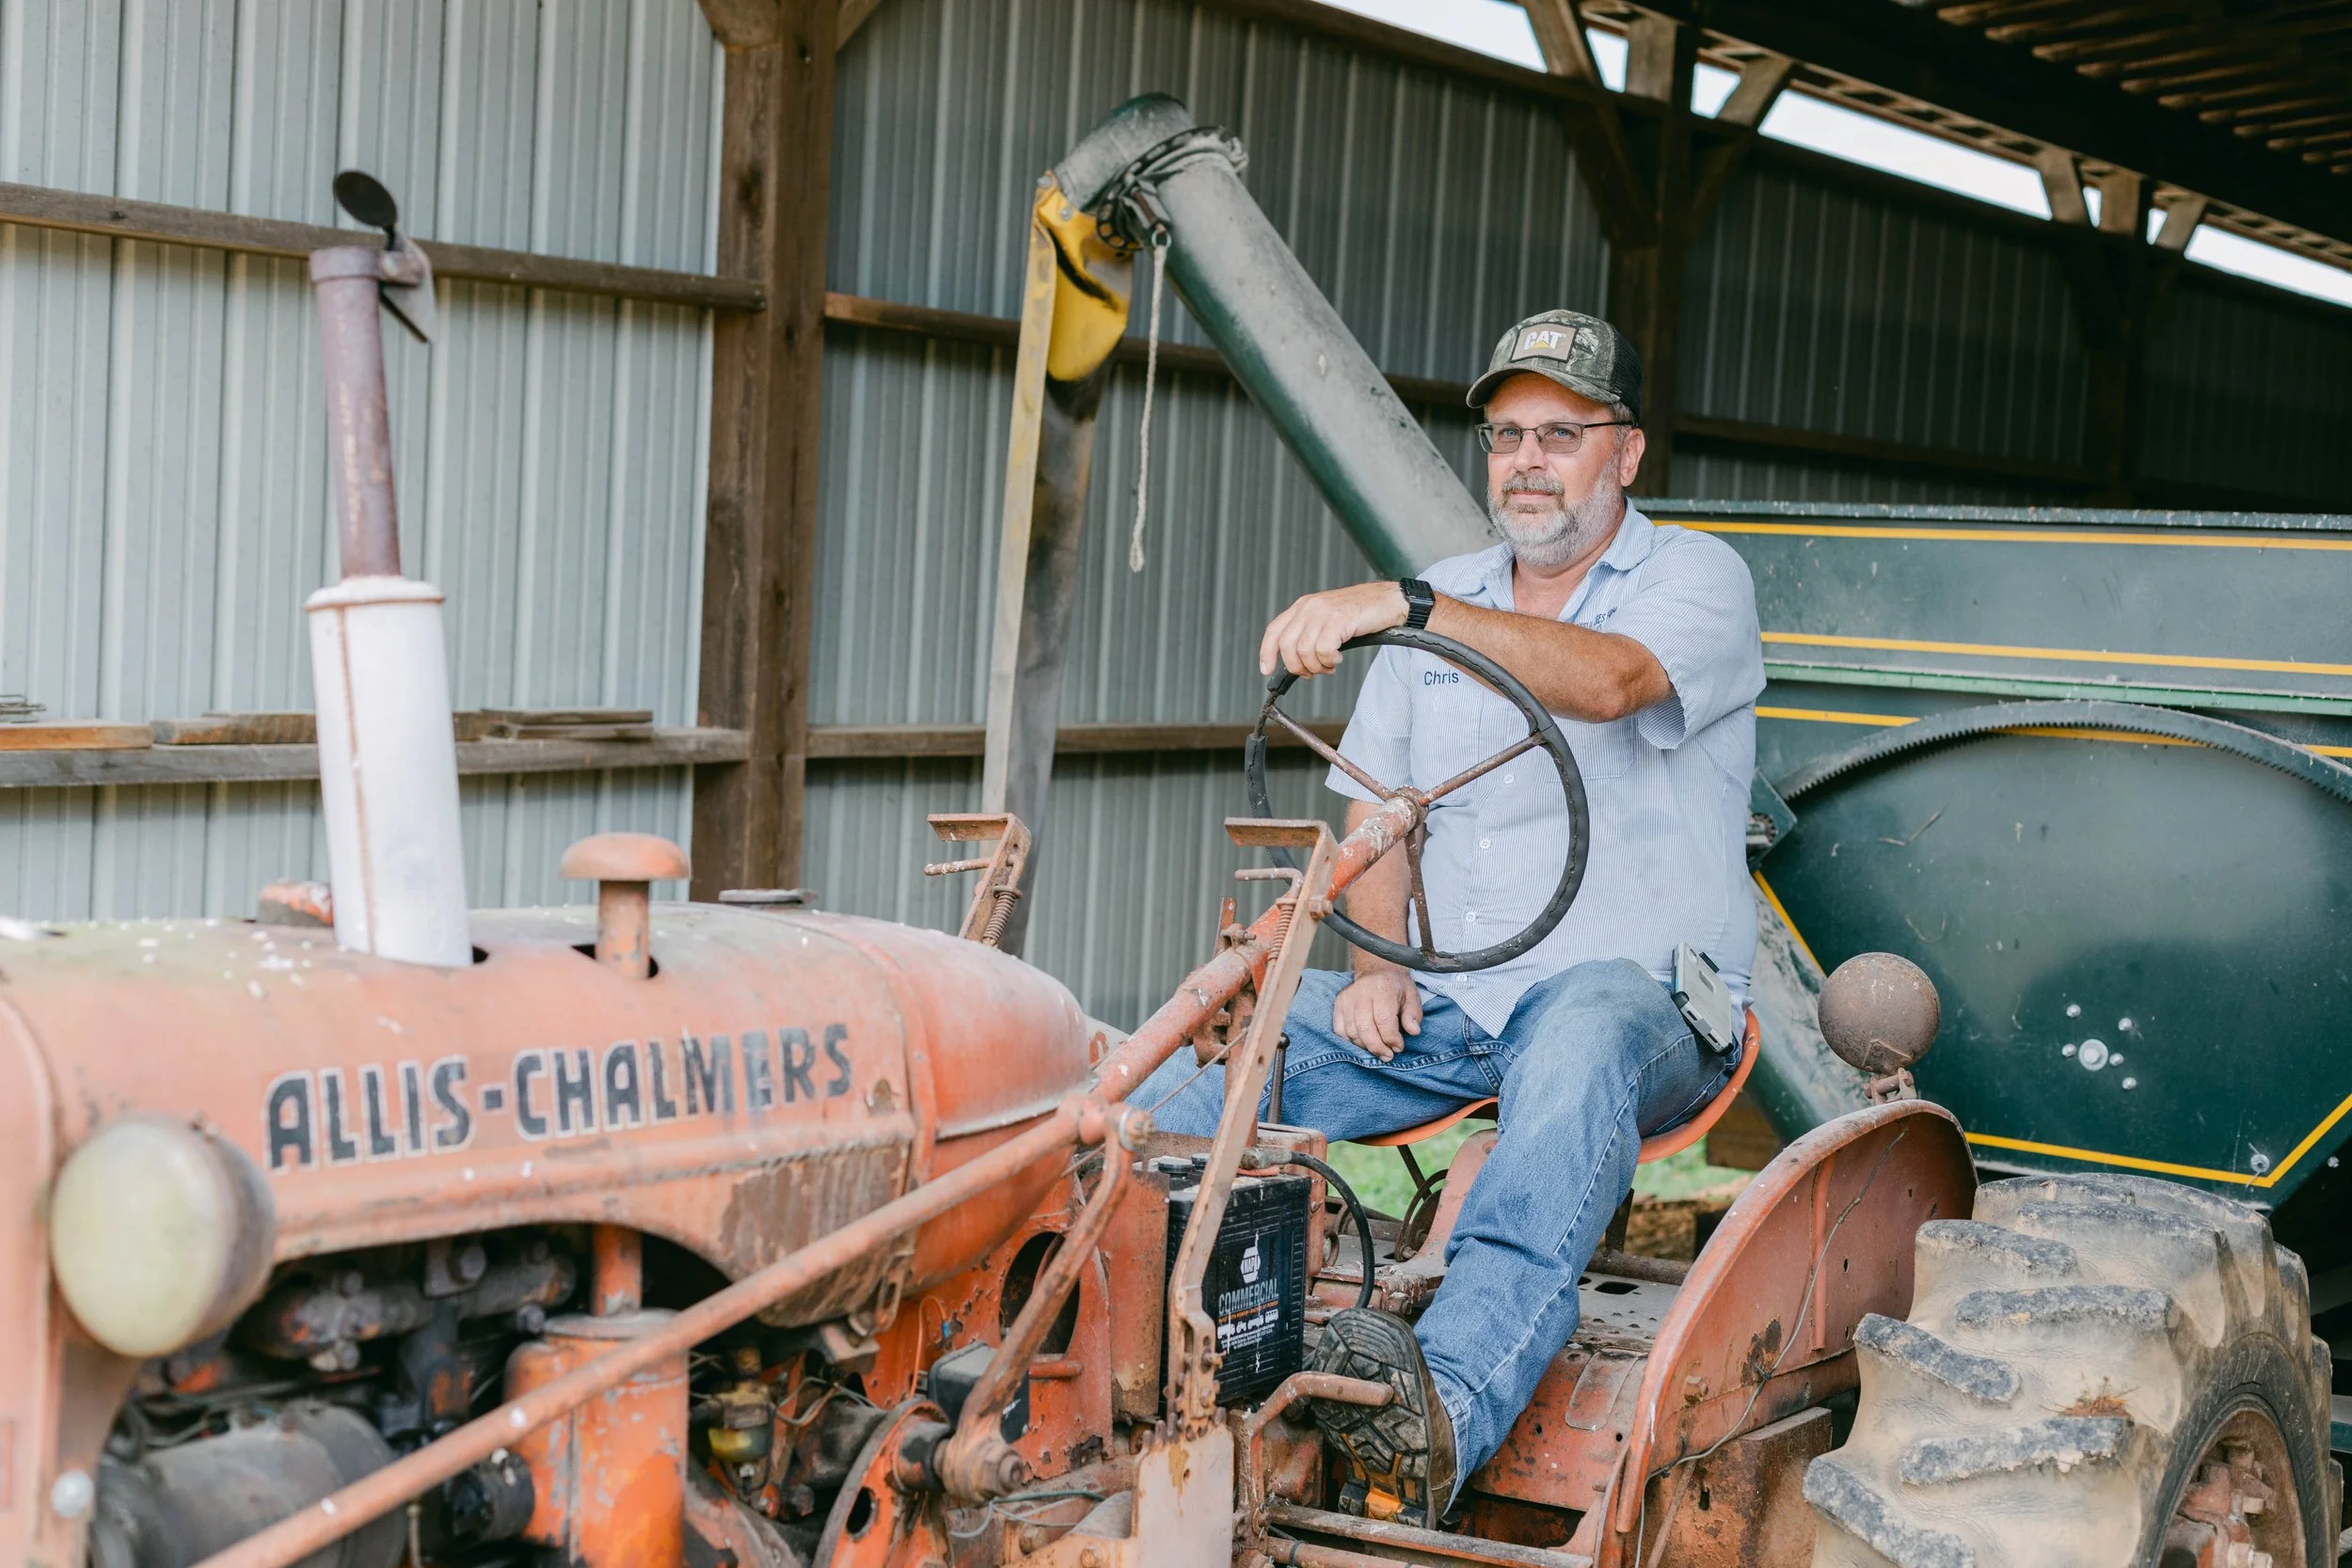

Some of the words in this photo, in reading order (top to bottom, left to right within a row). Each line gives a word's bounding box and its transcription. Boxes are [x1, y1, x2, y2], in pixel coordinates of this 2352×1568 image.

[1524, 330, 1562, 349] CAT
[1423, 671, 1459, 686] Chris
[265, 1022, 852, 1171] ALLIS-CHALMERS
[1218, 1279, 1279, 1315] COMMERCIAL
